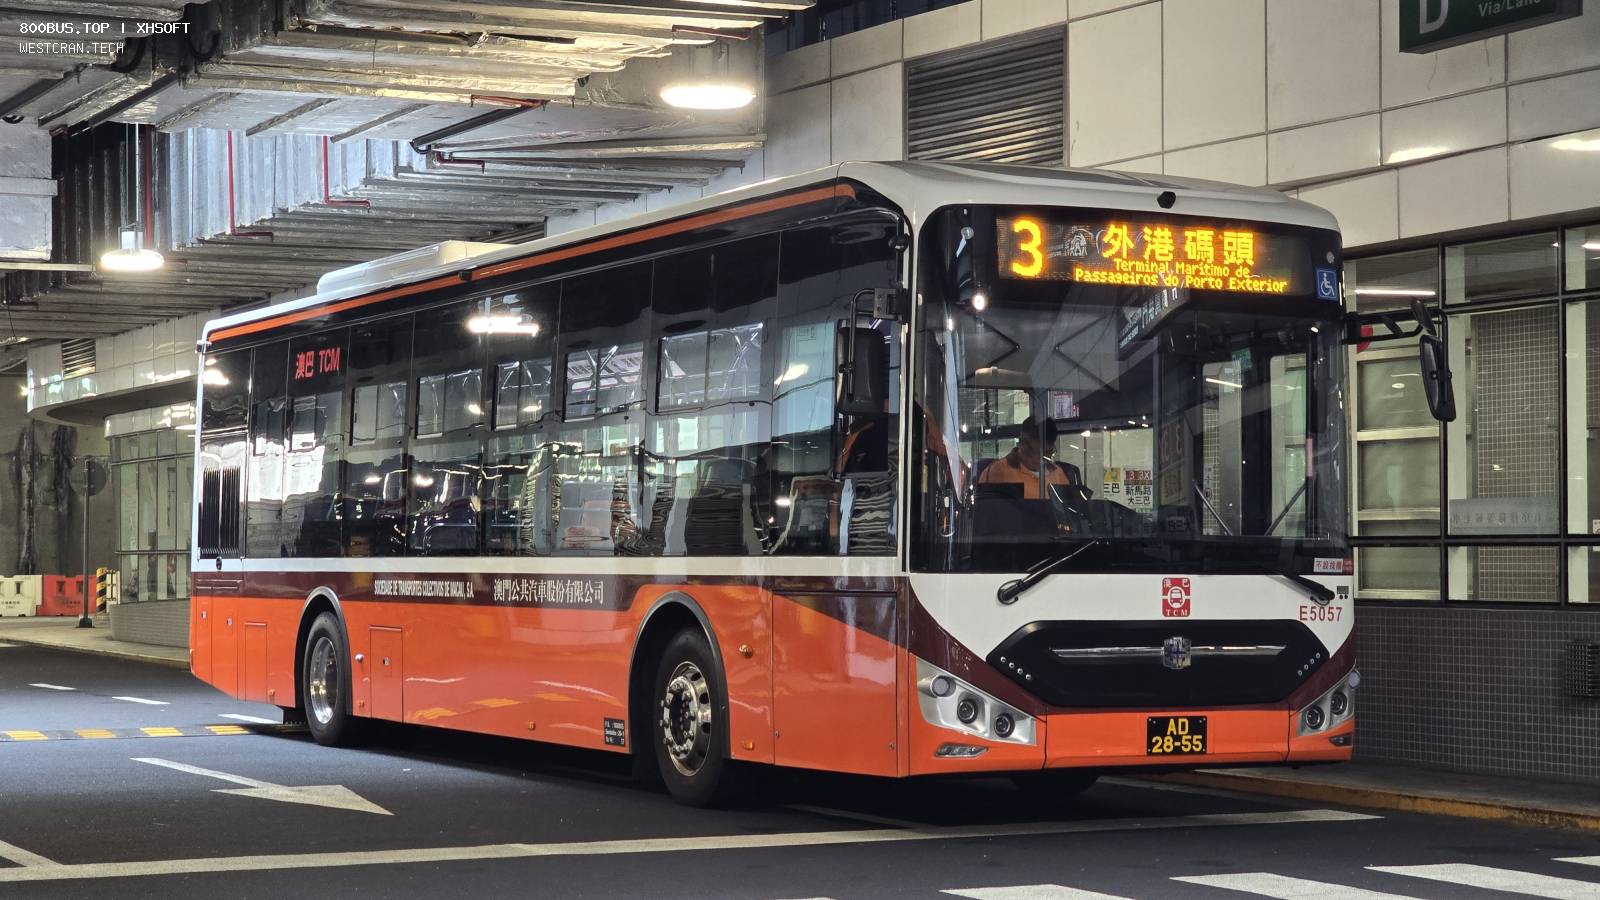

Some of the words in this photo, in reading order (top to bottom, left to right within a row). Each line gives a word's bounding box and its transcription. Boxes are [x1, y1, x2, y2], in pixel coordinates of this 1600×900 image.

[1011, 218, 1043, 278] 3
[1102, 224, 1255, 266] 外港碼頭
[1075, 268, 1159, 286] Passageiros
[1164, 274, 1179, 287] do
[1185, 275, 1223, 289] Porto
[1229, 277, 1288, 293] Exterior
[1114, 258, 1170, 274] Terminal
[1235, 264, 1250, 278] de
[319, 347, 341, 373] TCM
[494, 578, 604, 605] 澳門公共汽車股份有限公司
[1299, 605, 1343, 622] E5057
[1166, 718, 1189, 735] AD
[1151, 735, 1203, 753] 28-55
